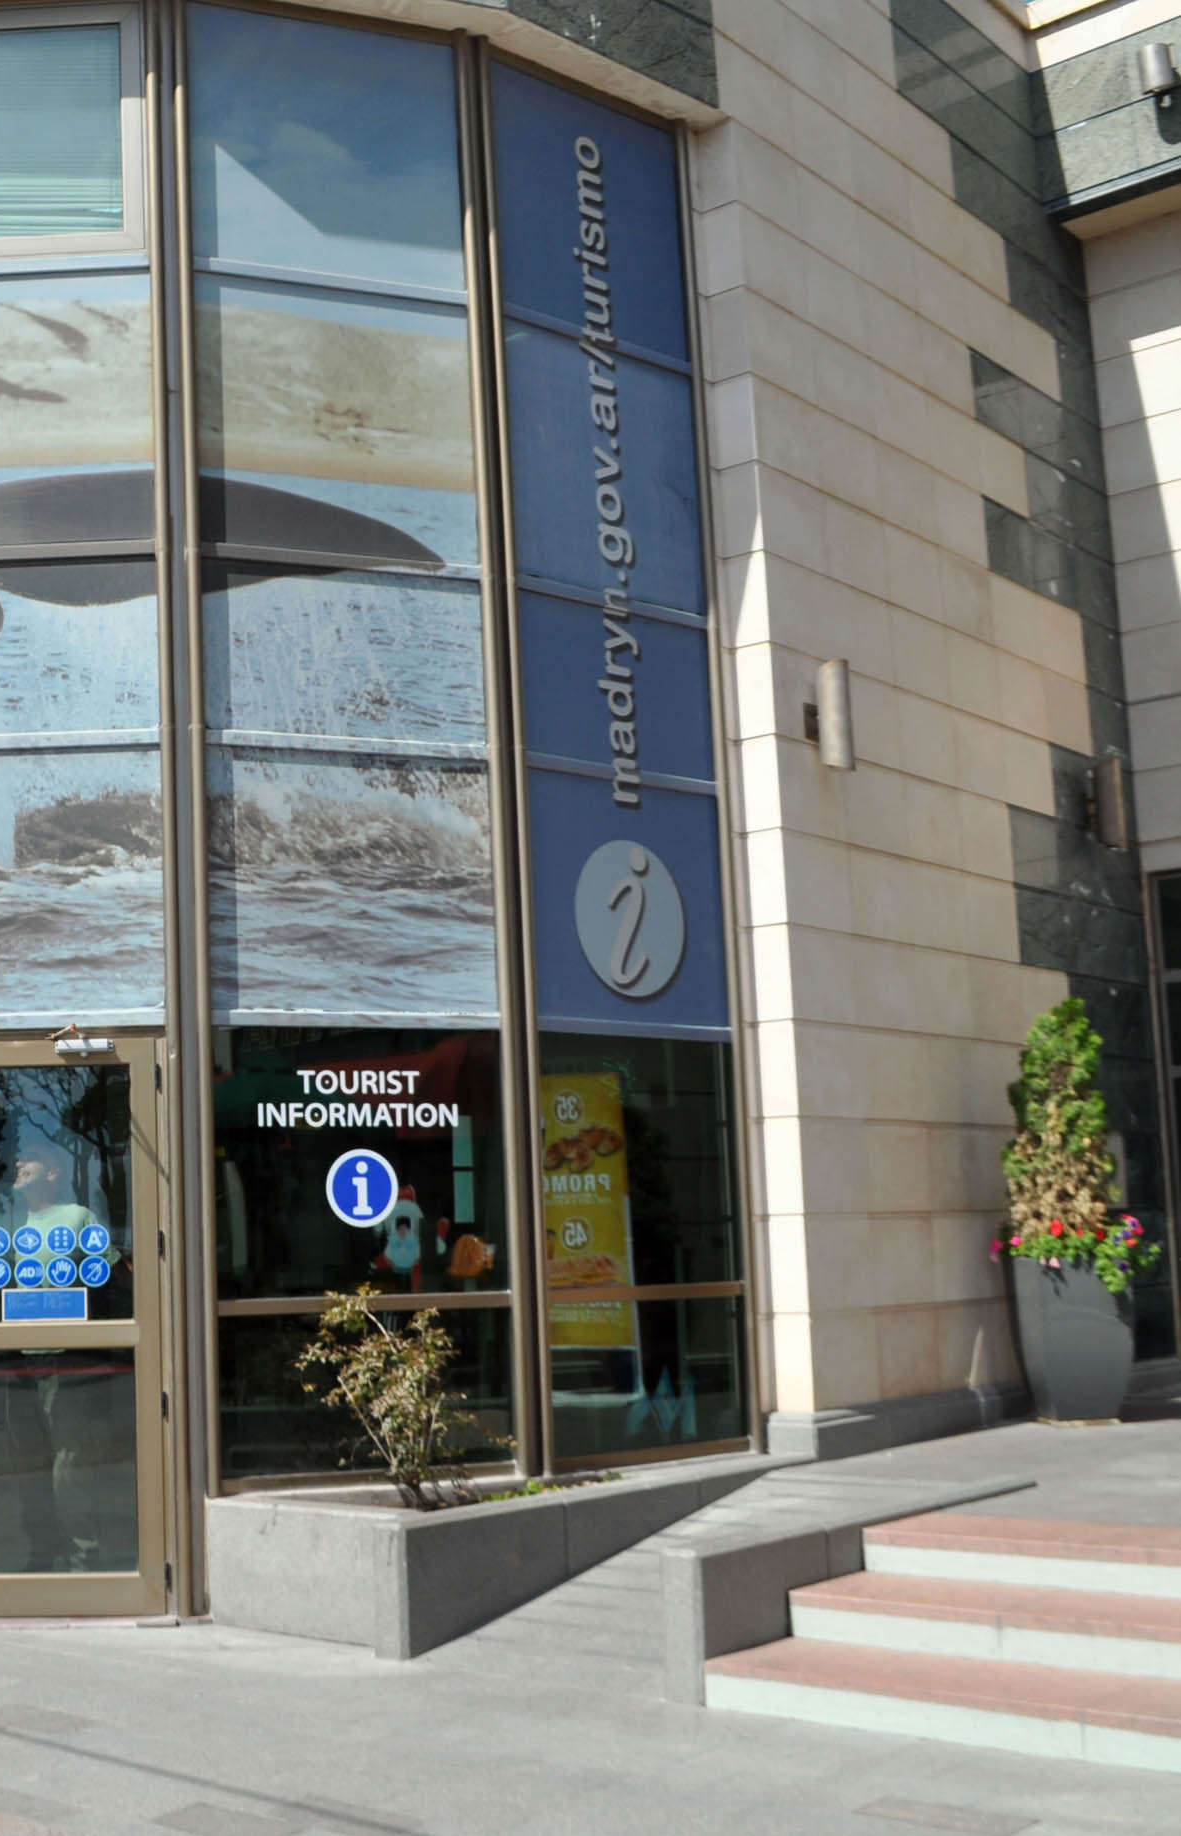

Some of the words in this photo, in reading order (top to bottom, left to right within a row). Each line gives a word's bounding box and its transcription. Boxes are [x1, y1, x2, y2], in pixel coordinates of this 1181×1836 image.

[574, 135, 639, 804] madryn.gov.ar/turismo
[296, 1069, 421, 1096] TOURIST
[256, 1101, 459, 1129] INFORMATION
